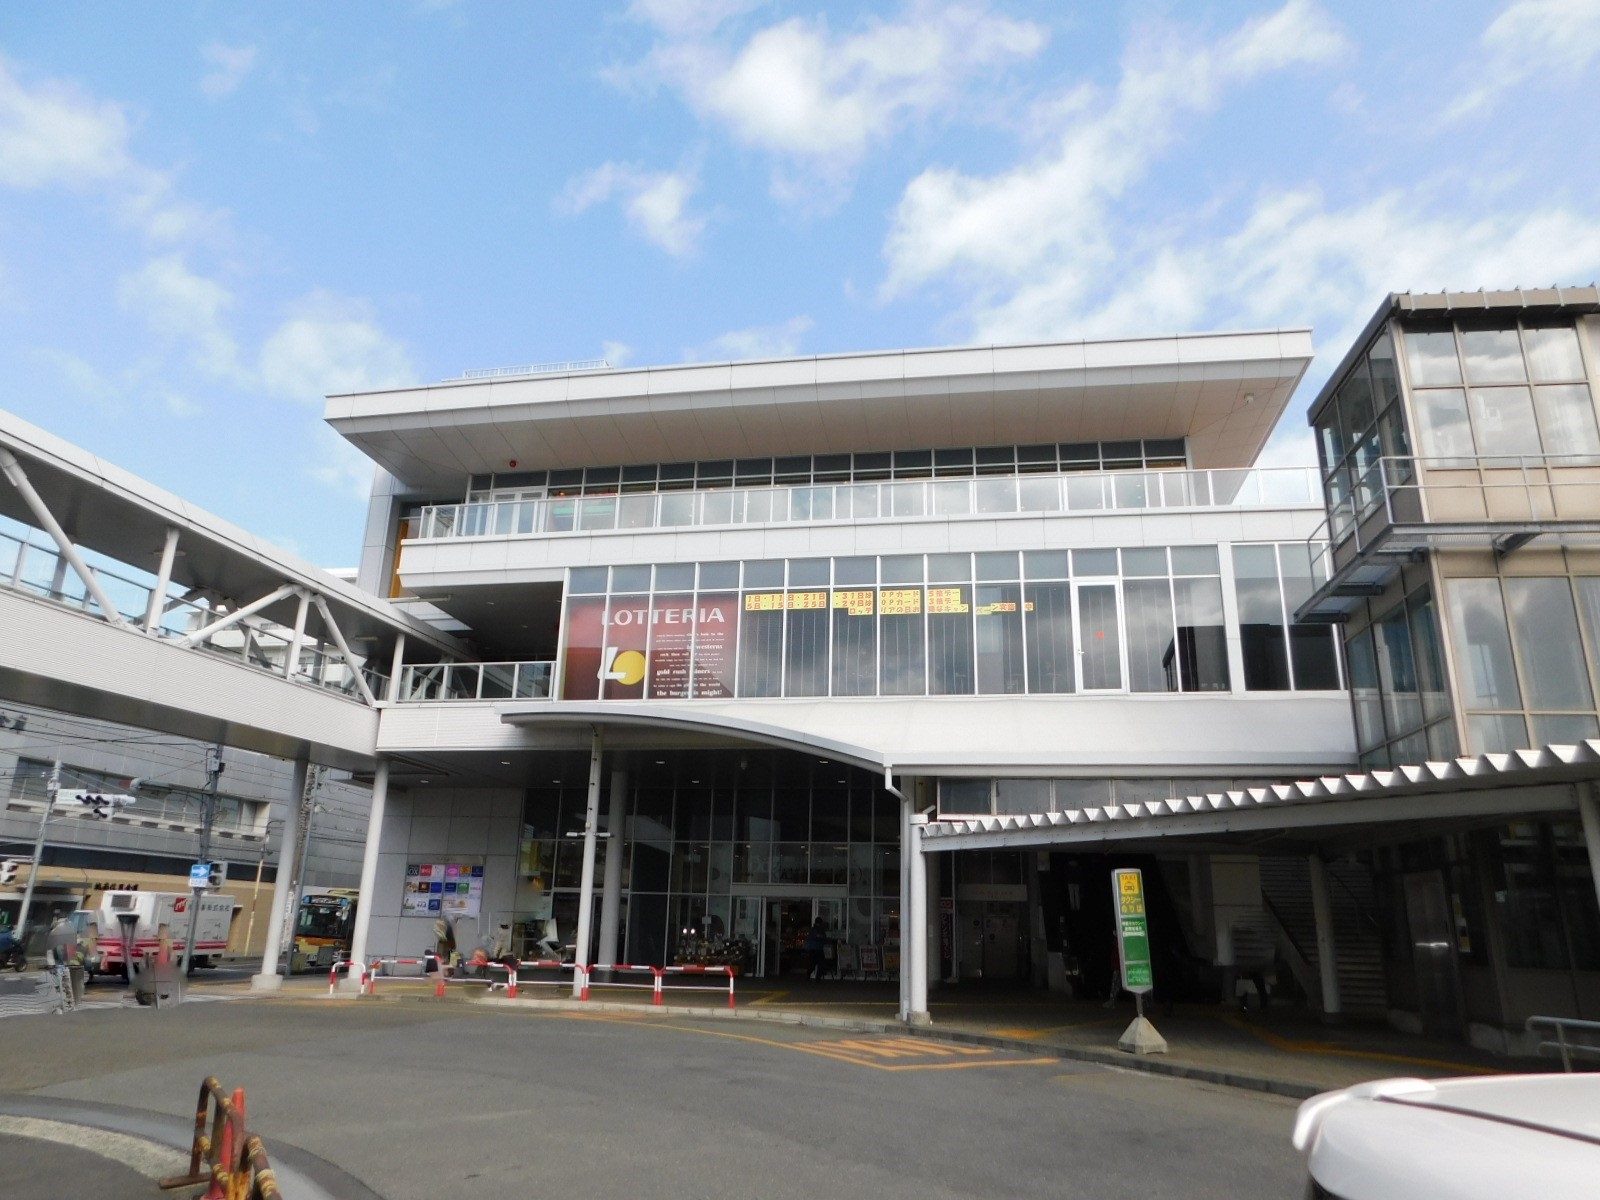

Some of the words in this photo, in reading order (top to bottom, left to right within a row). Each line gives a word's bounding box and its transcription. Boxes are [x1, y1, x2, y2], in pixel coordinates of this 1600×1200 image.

[601, 607, 725, 626] LOTTERIA
[1121, 896, 1142, 904] タクシー
